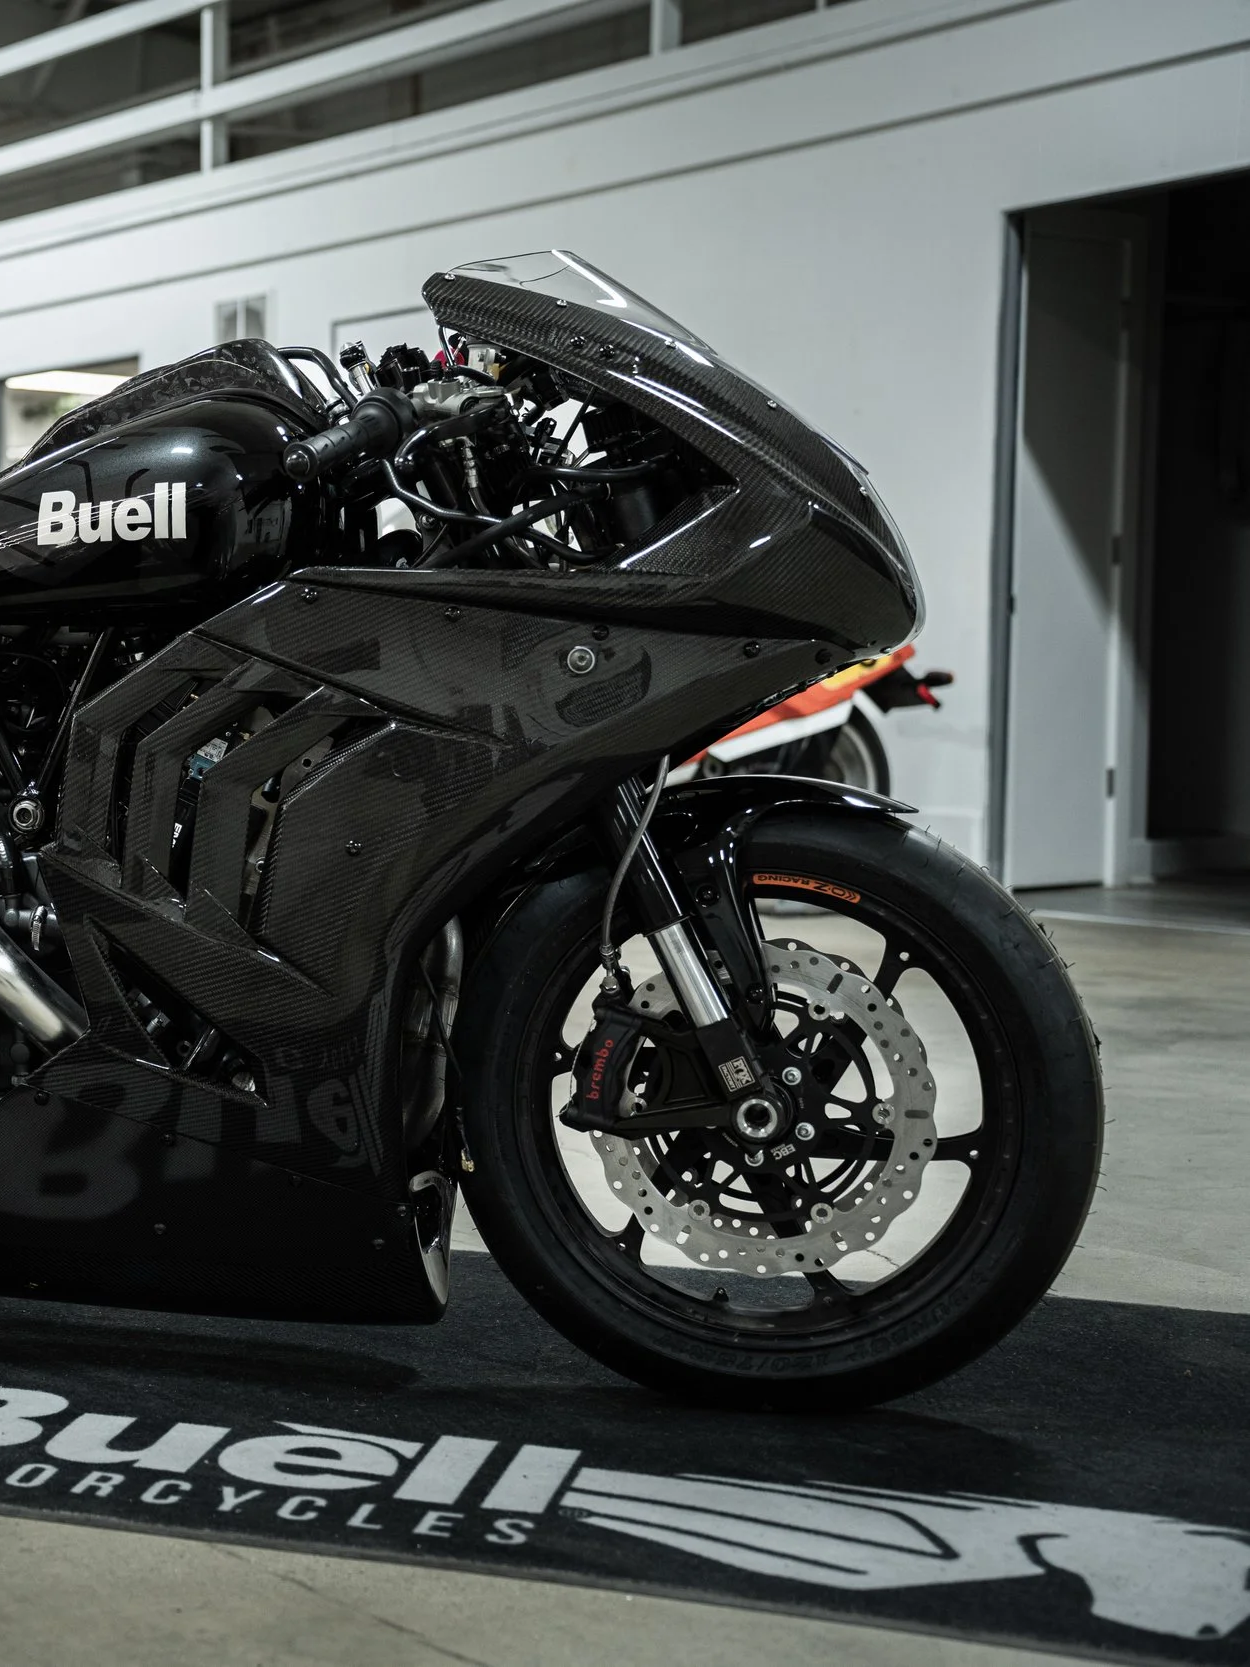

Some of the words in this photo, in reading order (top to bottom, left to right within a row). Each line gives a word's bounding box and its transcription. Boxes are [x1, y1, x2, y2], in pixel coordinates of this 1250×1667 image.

[37, 482, 187, 546] Buell
[757, 874, 810, 886] RACING
[585, 1039, 614, 1101] brembo
[732, 1059, 752, 1086] FOX
[772, 1143, 796, 1159] EBC
